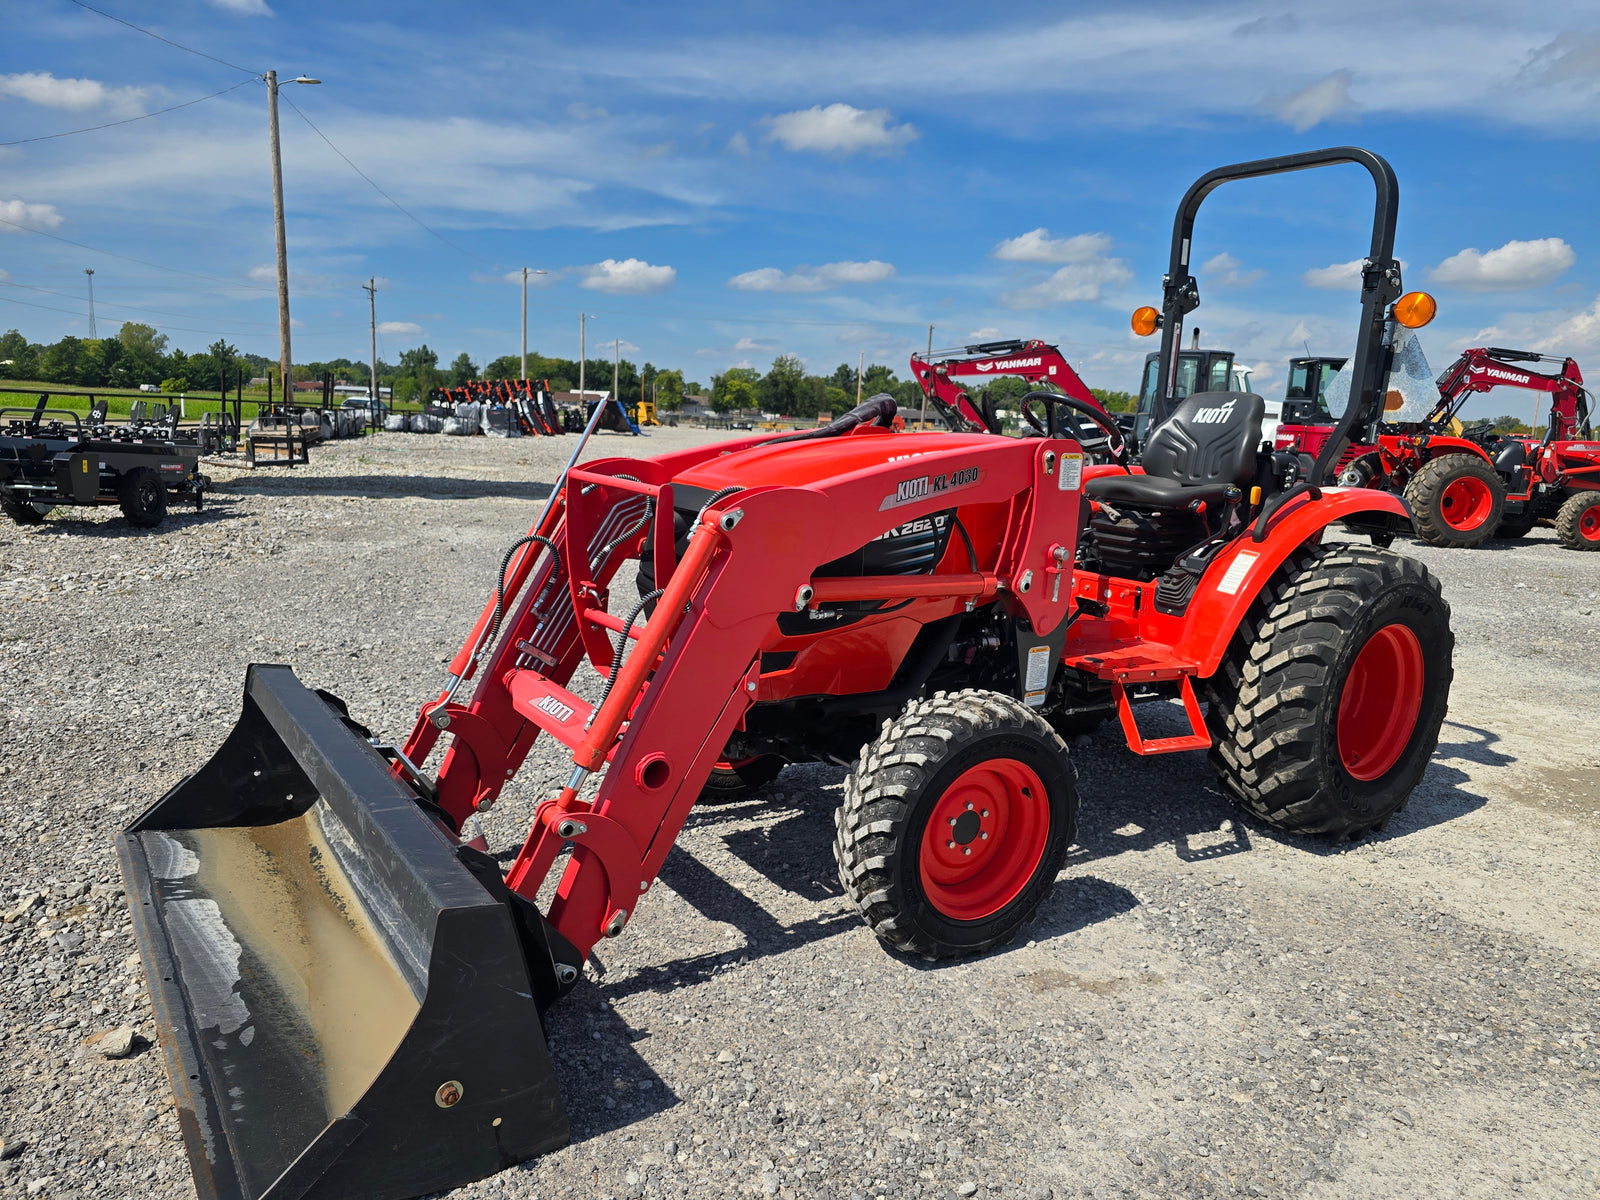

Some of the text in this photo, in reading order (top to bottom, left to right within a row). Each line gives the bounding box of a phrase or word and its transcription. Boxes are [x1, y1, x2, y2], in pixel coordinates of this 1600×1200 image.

[995, 357, 1042, 370] YANMAR
[1487, 368, 1530, 384] YANMAR
[1192, 407, 1234, 424] KIOTI
[896, 466, 979, 502] KIOTI KL 4030
[537, 694, 575, 723] KIOTI
